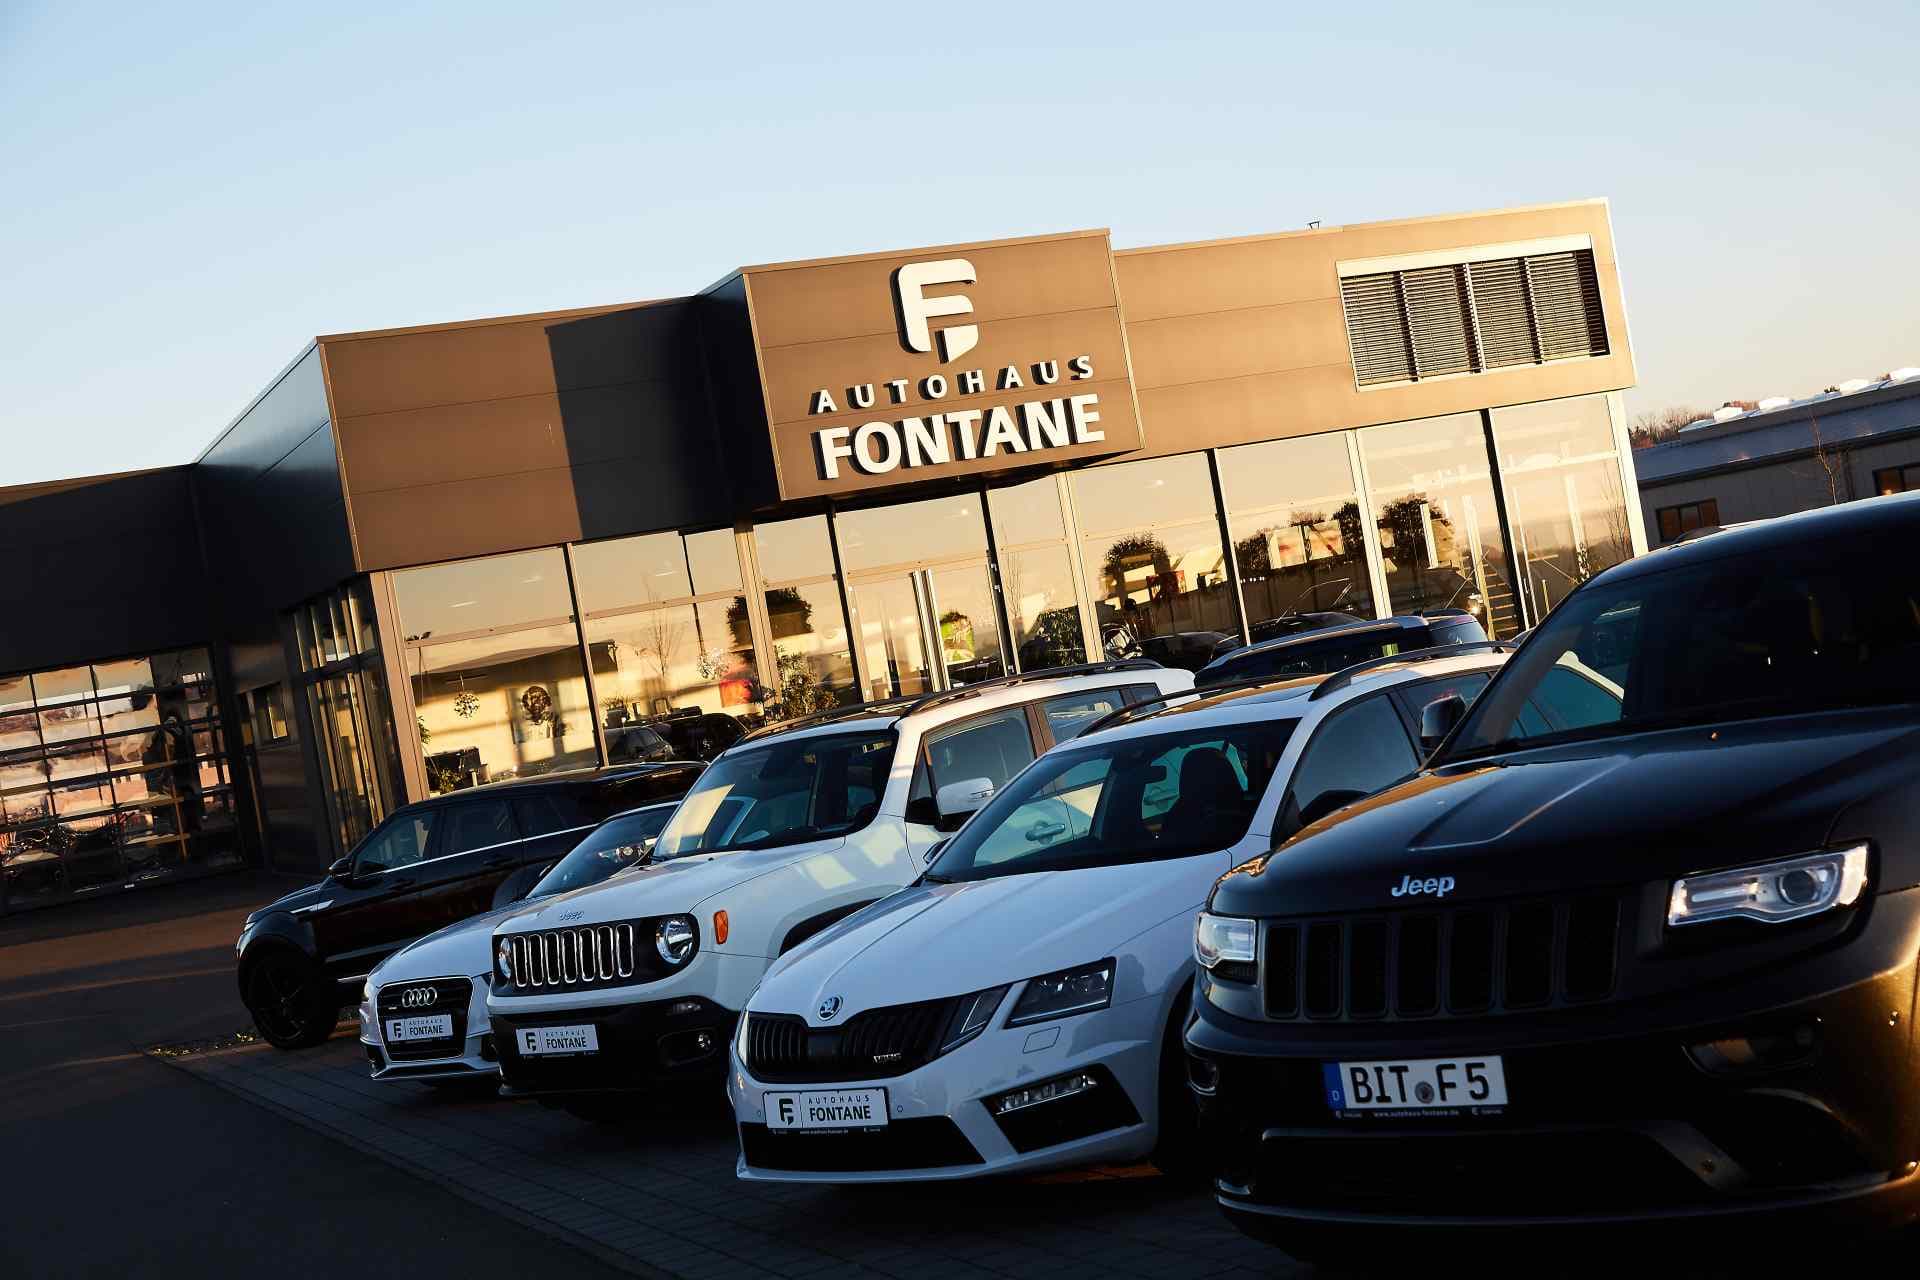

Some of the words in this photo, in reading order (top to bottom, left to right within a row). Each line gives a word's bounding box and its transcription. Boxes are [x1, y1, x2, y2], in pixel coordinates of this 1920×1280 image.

[815, 354, 1094, 413] AUTOHAUS
[818, 393, 1105, 479] FONTANE
[1391, 875, 1455, 897] Jeep
[409, 1024, 444, 1036] FONTANE
[546, 1036, 587, 1049] FONTANE
[1349, 1065, 1409, 1104] BIT
[808, 1094, 870, 1105] AUTOHAUS
[809, 1105, 872, 1122] FONTANE
